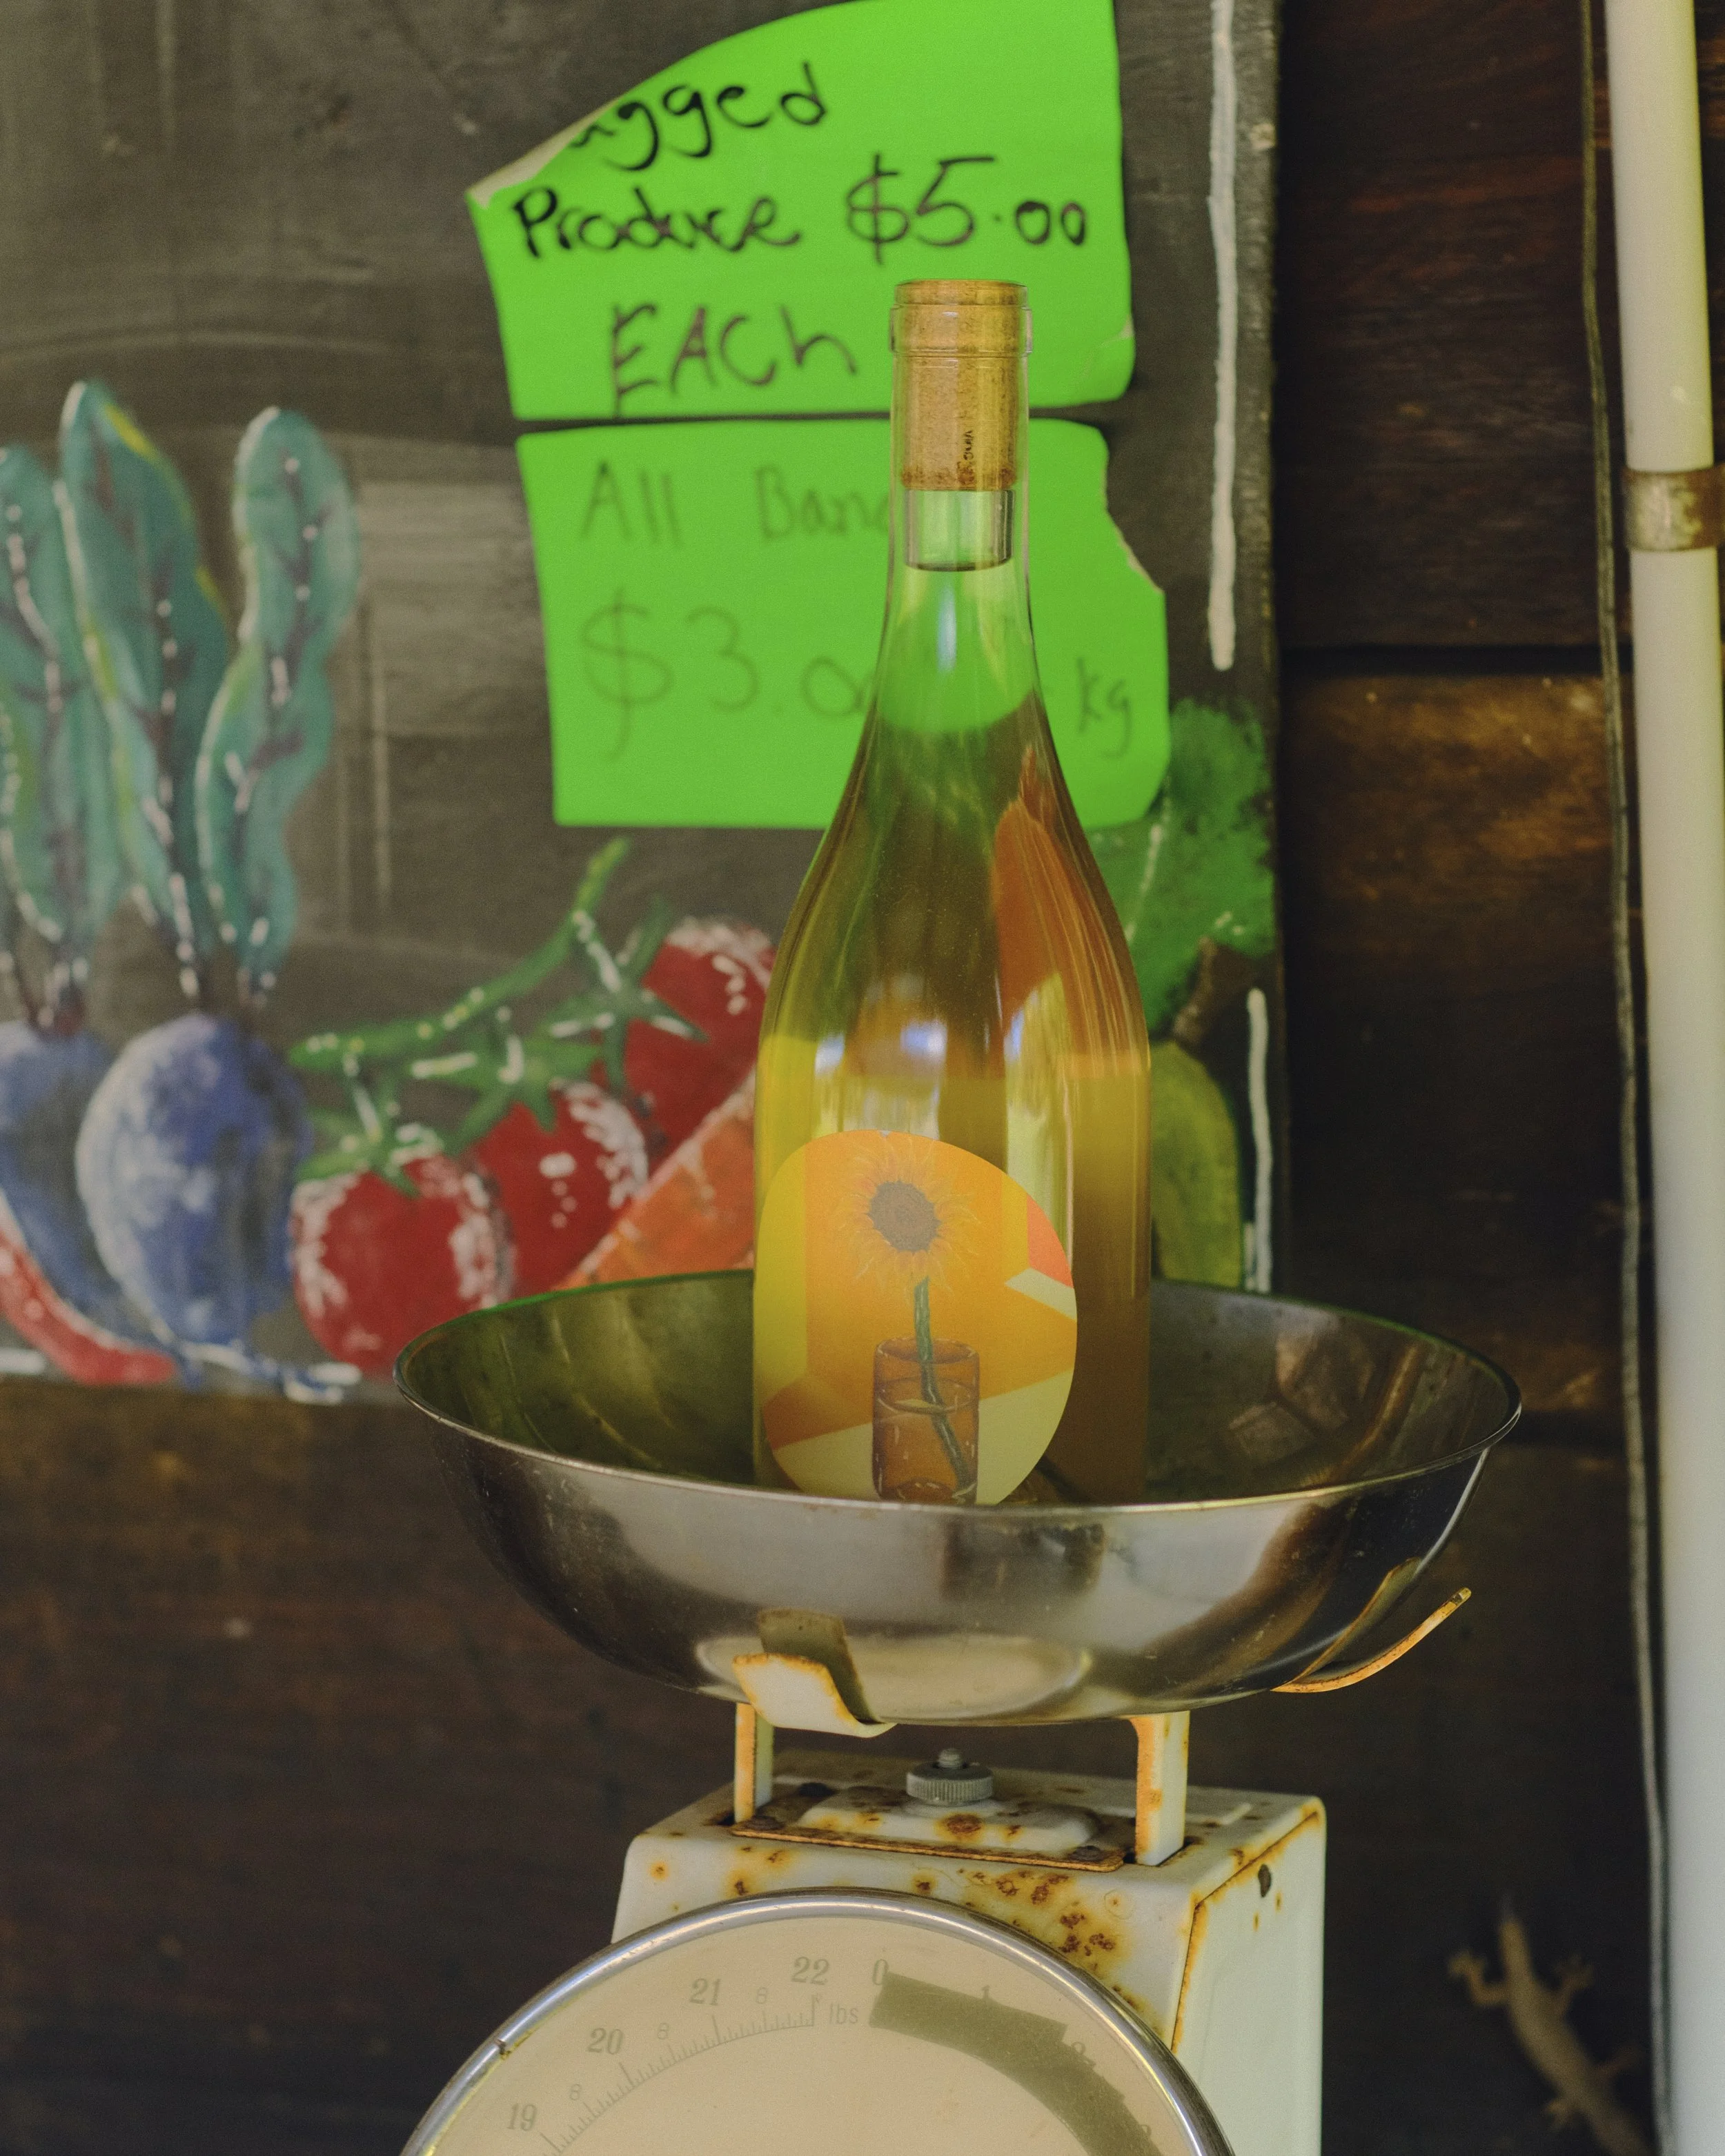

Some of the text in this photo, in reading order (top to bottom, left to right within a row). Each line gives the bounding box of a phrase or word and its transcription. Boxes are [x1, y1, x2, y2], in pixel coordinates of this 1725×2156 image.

[567, 62, 827, 171] gged
[512, 152, 1088, 266] Produce $5.00
[581, 461, 680, 544] All
[579, 589, 1132, 760] $3.0 kg
[791, 1957, 829, 1986] 22
[871, 1959, 887, 1986] 0
[689, 1977, 721, 2006] 21
[828, 2003, 859, 2025] lbs
[587, 2026, 624, 2055] 20
[656, 2022, 670, 2041] 8
[569, 2083, 583, 2101] 8
[506, 2103, 538, 2132] 19
